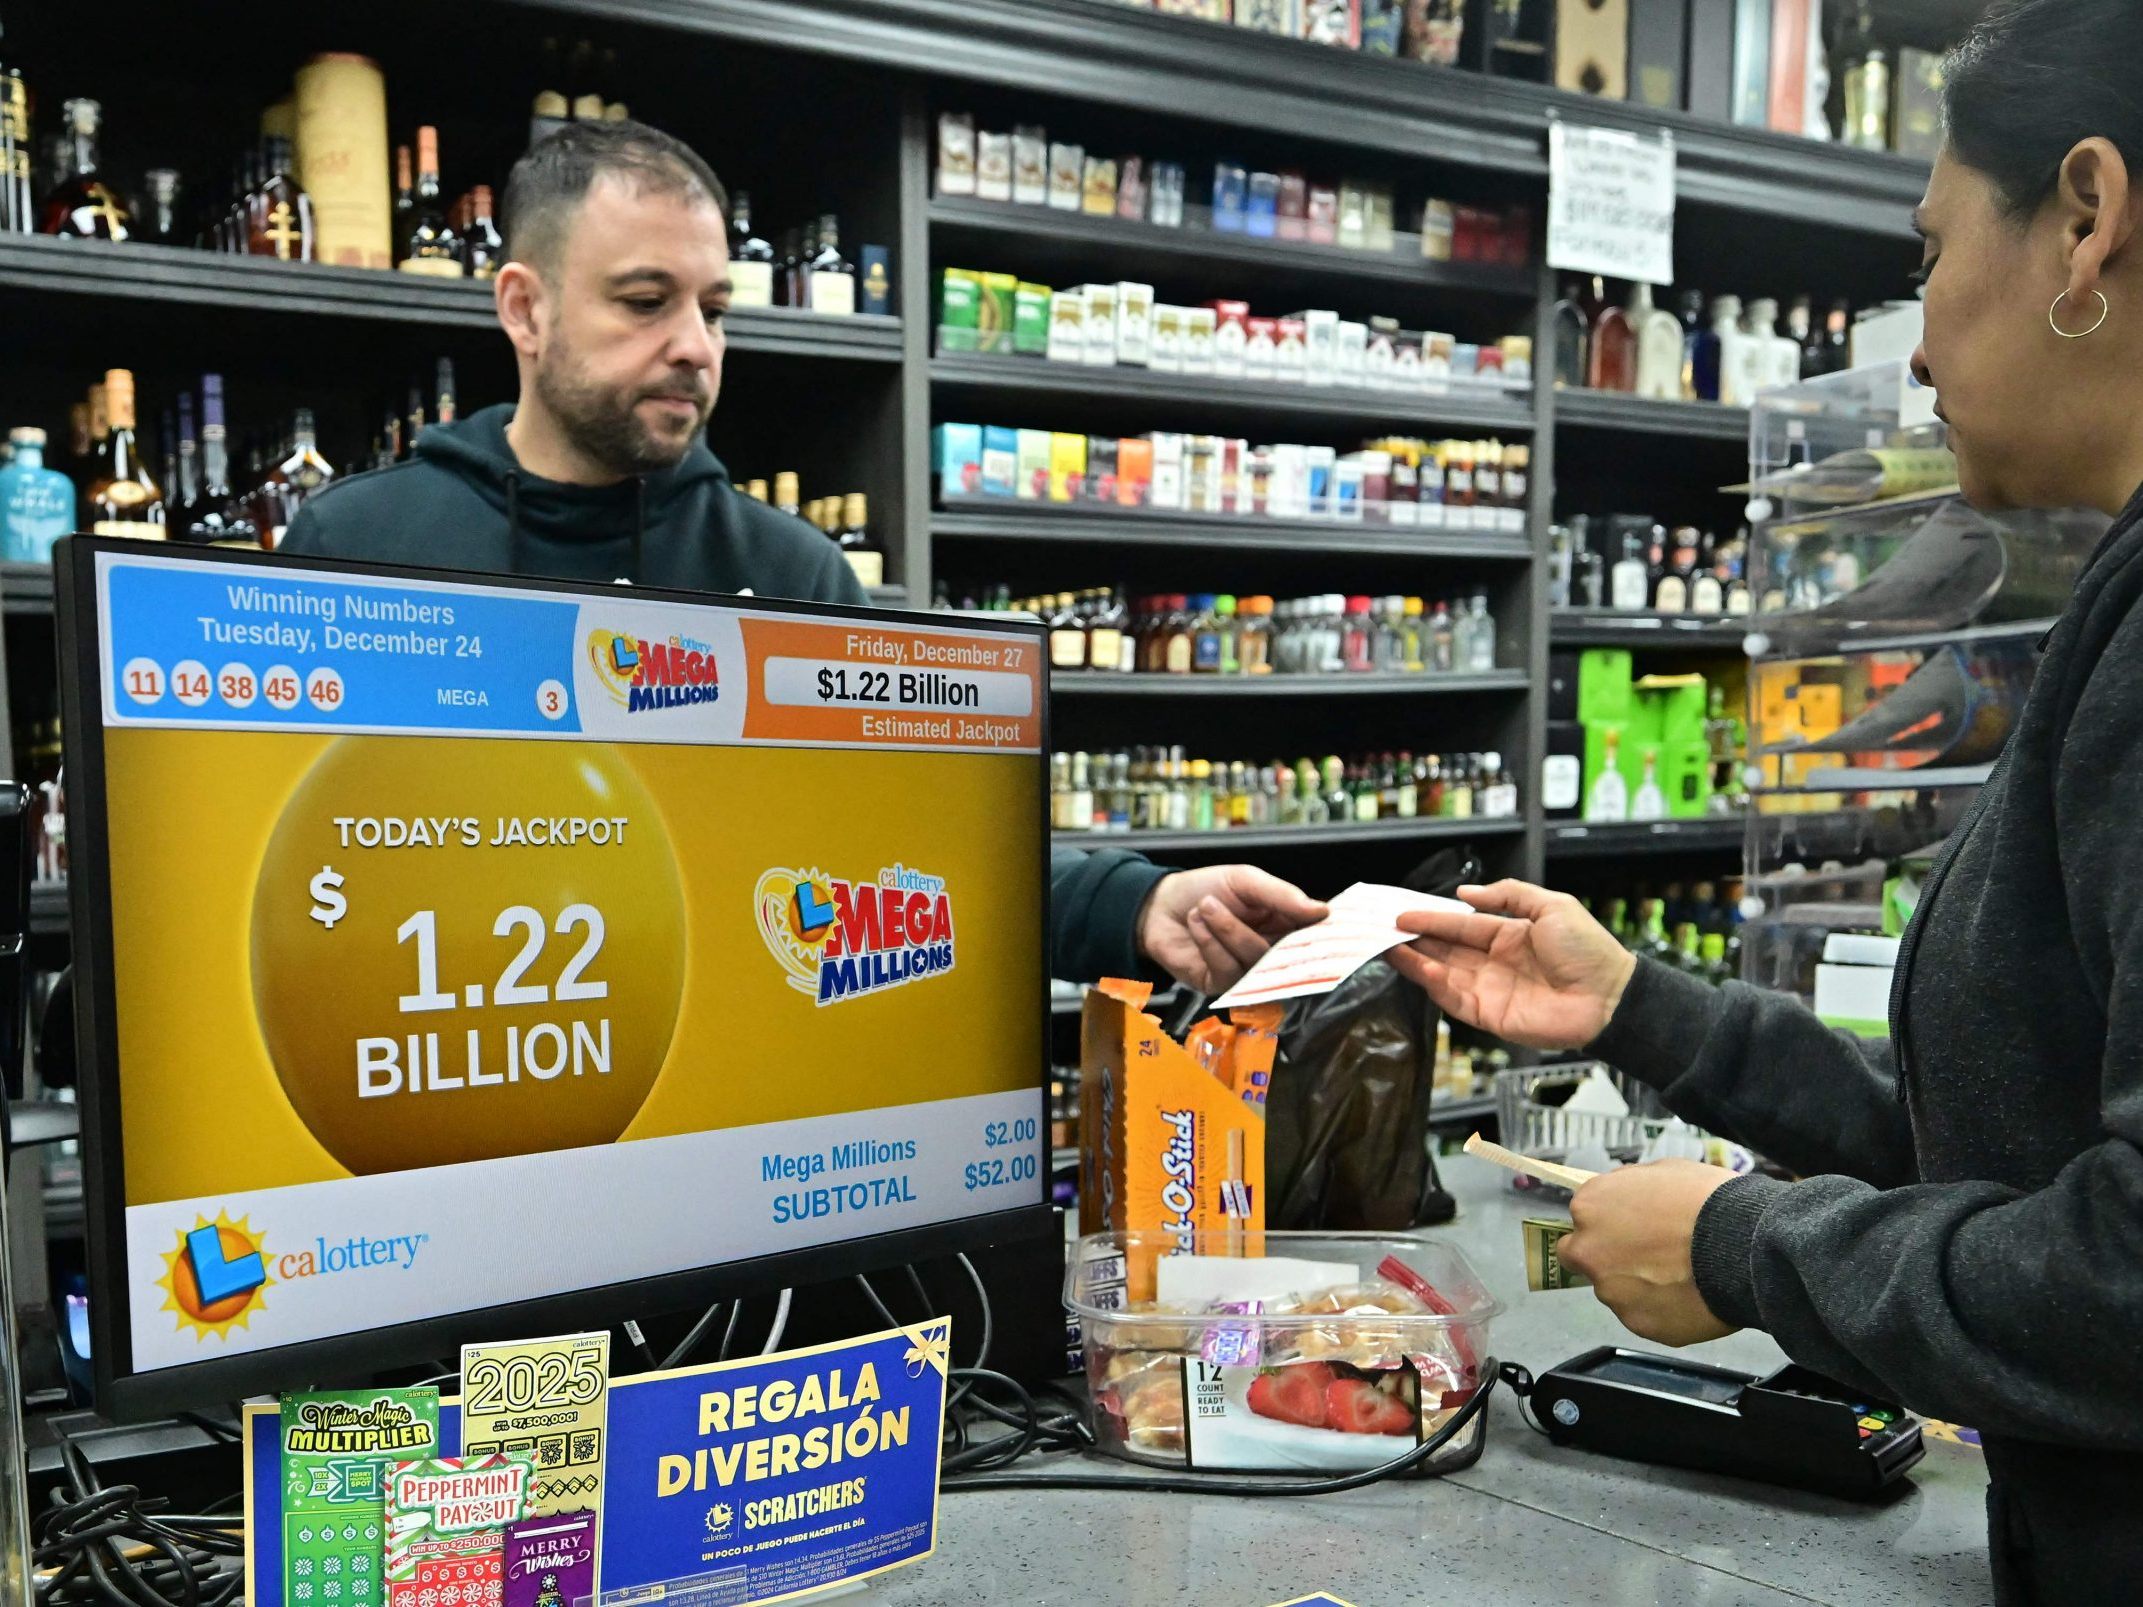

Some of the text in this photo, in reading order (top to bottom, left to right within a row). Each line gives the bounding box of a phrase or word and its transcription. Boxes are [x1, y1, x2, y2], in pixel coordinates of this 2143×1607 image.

[227, 585, 455, 626] Winning Numbers
[197, 616, 482, 660] Tuesday, December 24
[847, 633, 1023, 668] Friday, December 27
[630, 640, 718, 688] MEGA
[130, 670, 341, 703] 11 14 38 45 46
[437, 688, 560, 712] MEGA 3
[628, 684, 718, 714] MILLIONS
[817, 667, 979, 707] $1.22 Billion
[862, 714, 1020, 747] Estimated Jackpot
[334, 816, 628, 848] TODAY'S JACKPOT
[880, 863, 941, 895] calottery
[308, 865, 348, 929] $
[823, 881, 952, 958] MEGA
[397, 903, 608, 1012] 1.22
[819, 944, 952, 1000] MILLIONS
[356, 1018, 611, 1098] BILLION
[1138, 1040, 1153, 1057] 24
[762, 1117, 1036, 1183] Mega Millions $2.00
[772, 1154, 1036, 1224] SUBTOTAL $52.00
[1161, 1109, 1196, 1256] ick-O-Stick
[467, 1347, 604, 1417] 2025
[698, 1362, 881, 1436] REGALA
[1197, 1383, 1224, 1392] COUNT
[303, 1400, 411, 1430] Winter Magic
[1197, 1397, 1224, 1405] READY
[1211, 1405, 1225, 1413] EAT
[290, 1423, 431, 1450] MULTIPLIER
[512, 1411, 578, 1429] $7,500,000!
[541, 1440, 562, 1448] BONUS
[574, 1434, 594, 1443] BONUS
[657, 1405, 910, 1498] DIVERSIÓN
[403, 1469, 522, 1503] PEPPERMINT
[744, 1476, 866, 1530] SCRATCHERS
[412, 1545, 426, 1554] WIN
[428, 1544, 438, 1552] UP
[521, 1535, 582, 1557] MERRY
[702, 1553, 714, 1561] UN
[715, 1547, 742, 1559] POCO
[743, 1544, 754, 1553] DE
[755, 1539, 783, 1552] JUEGO
[784, 1533, 809, 1545] PUEDE
[809, 1525, 844, 1539] HACERTE
[853, 1517, 866, 1527] DÍA
[515, 1551, 582, 1577] Wishes
